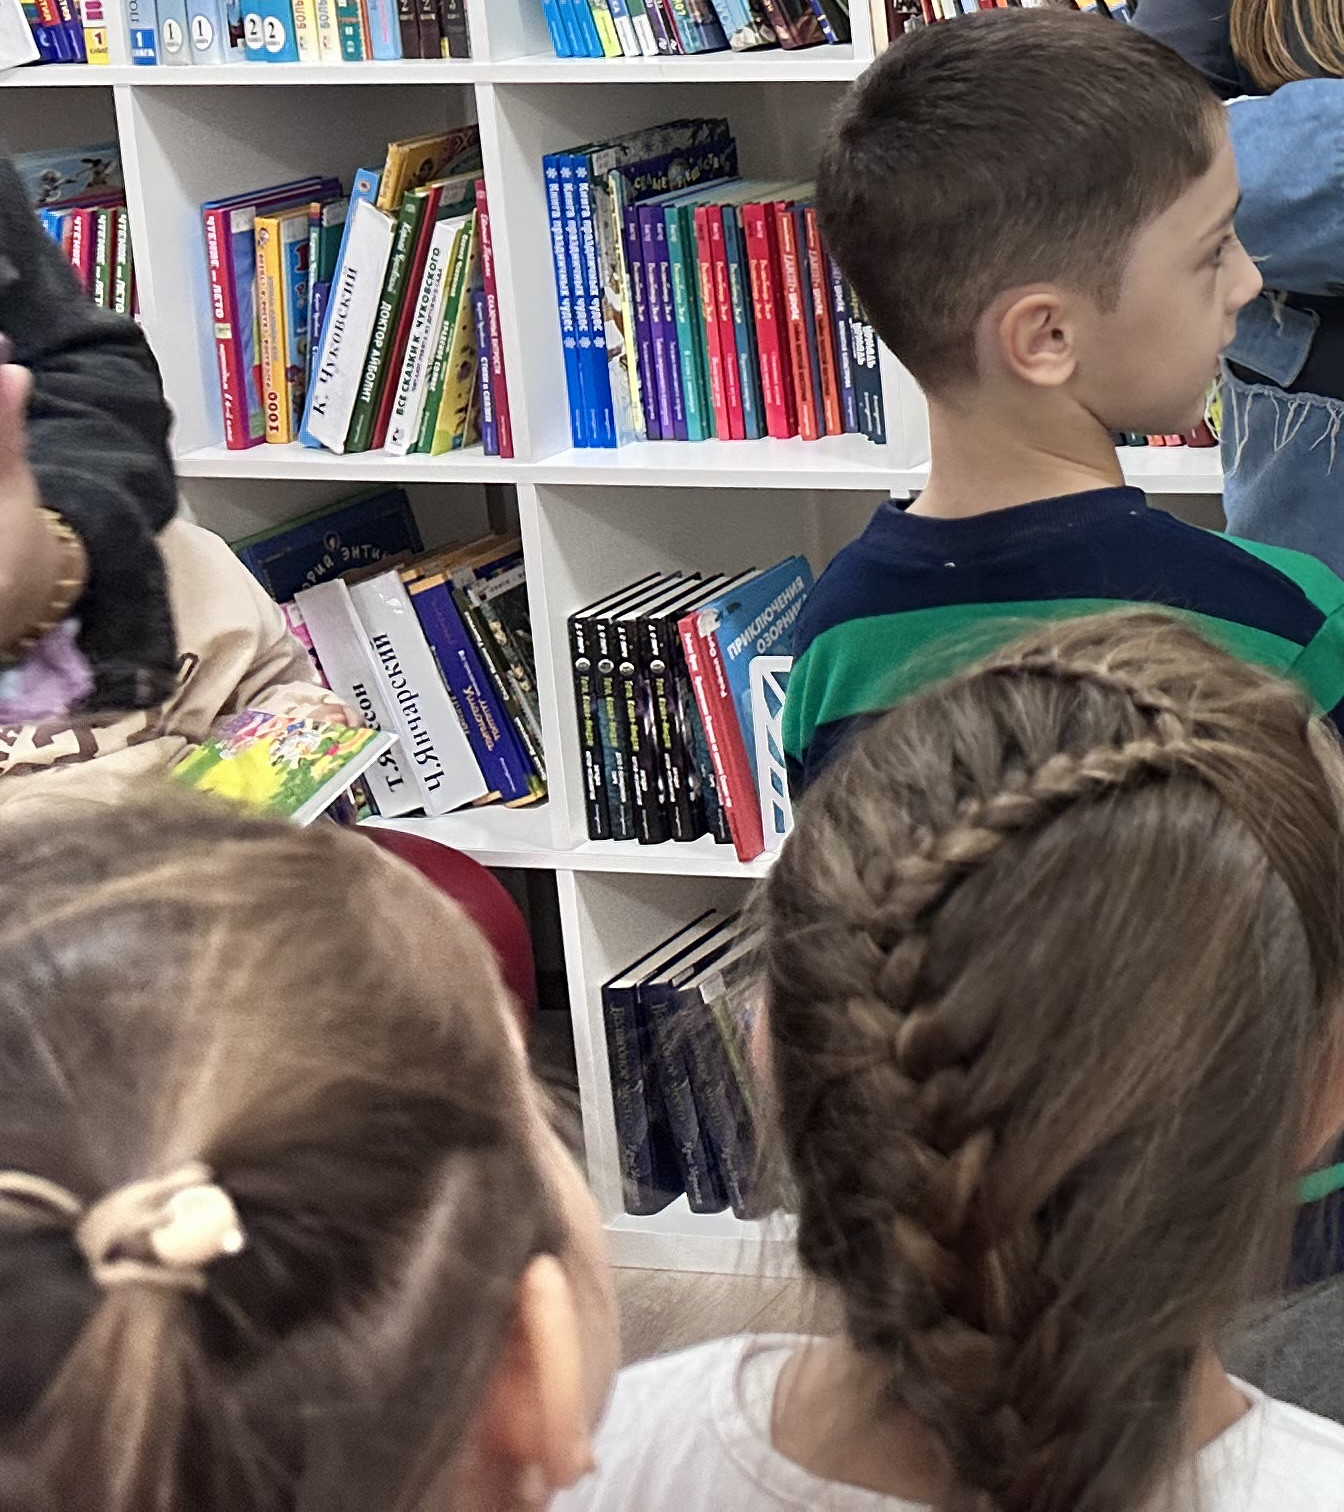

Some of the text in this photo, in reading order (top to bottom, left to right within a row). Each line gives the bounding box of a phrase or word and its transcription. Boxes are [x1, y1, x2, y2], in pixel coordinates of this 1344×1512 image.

[415, 248, 440, 327] ЧУКОВСКОГО
[549, 183, 563, 217] Книга
[559, 298, 575, 331] чудес
[361, 301, 392, 401] ДОКТОР АЙБОЛИТ
[401, 344, 419, 392] СКАЗКИ
[267, 392, 280, 433] 1000
[396, 395, 408, 415] ВСЕ
[370, 633, 446, 791] Ч.Янчарский
